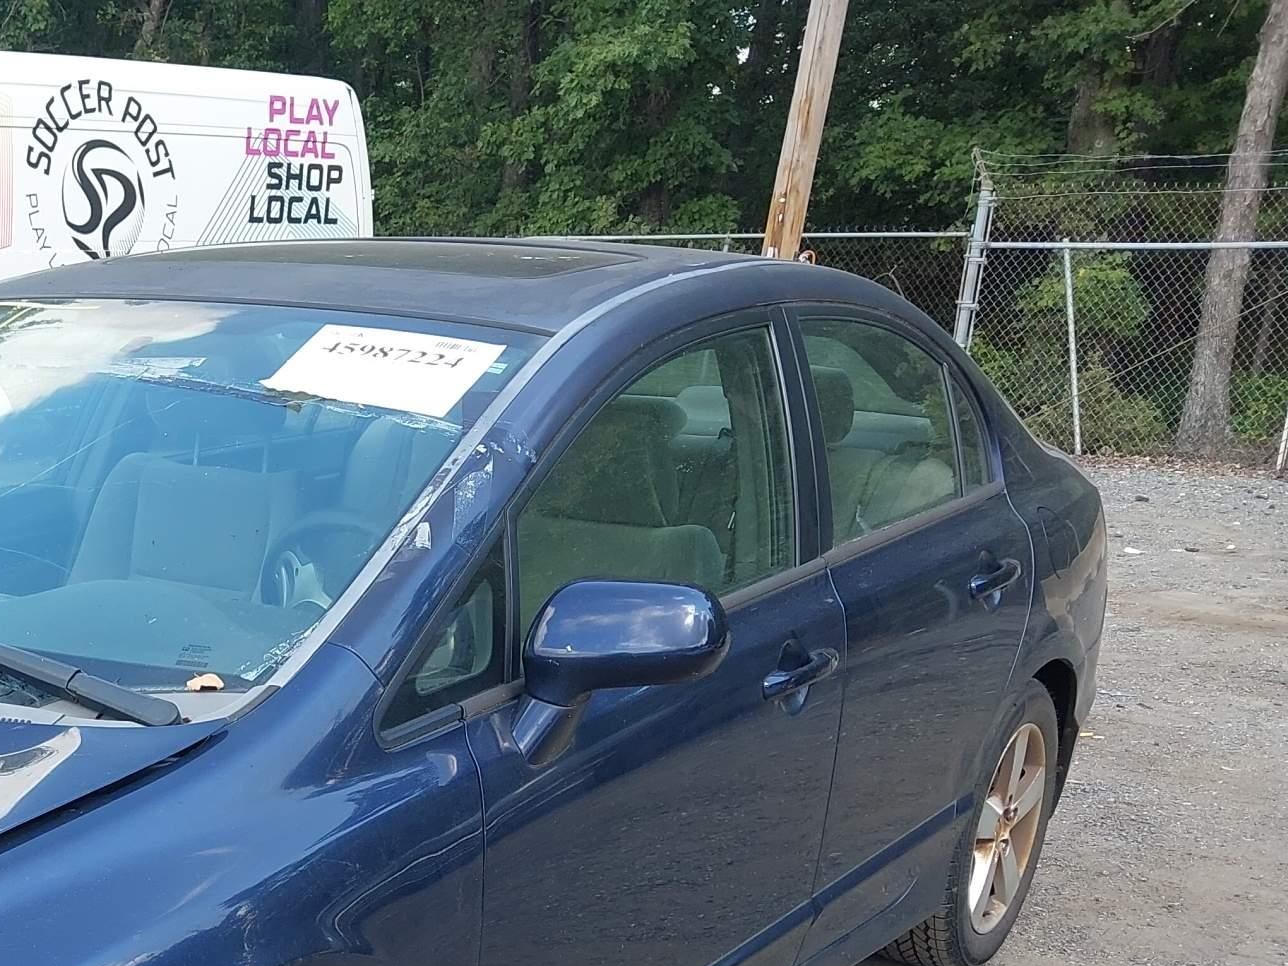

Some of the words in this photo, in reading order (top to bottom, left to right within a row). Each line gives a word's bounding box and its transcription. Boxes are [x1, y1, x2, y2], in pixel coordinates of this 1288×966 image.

[269, 95, 340, 126] PLAY
[26, 79, 113, 176] SOCCER
[121, 96, 176, 180] POST
[246, 127, 336, 159] LOCAL
[266, 162, 343, 192] SHOP
[26, 193, 52, 250] PLAY
[157, 194, 179, 251] OCAL
[248, 195, 338, 225] LOCAL
[322, 342, 464, 368] 45987224
